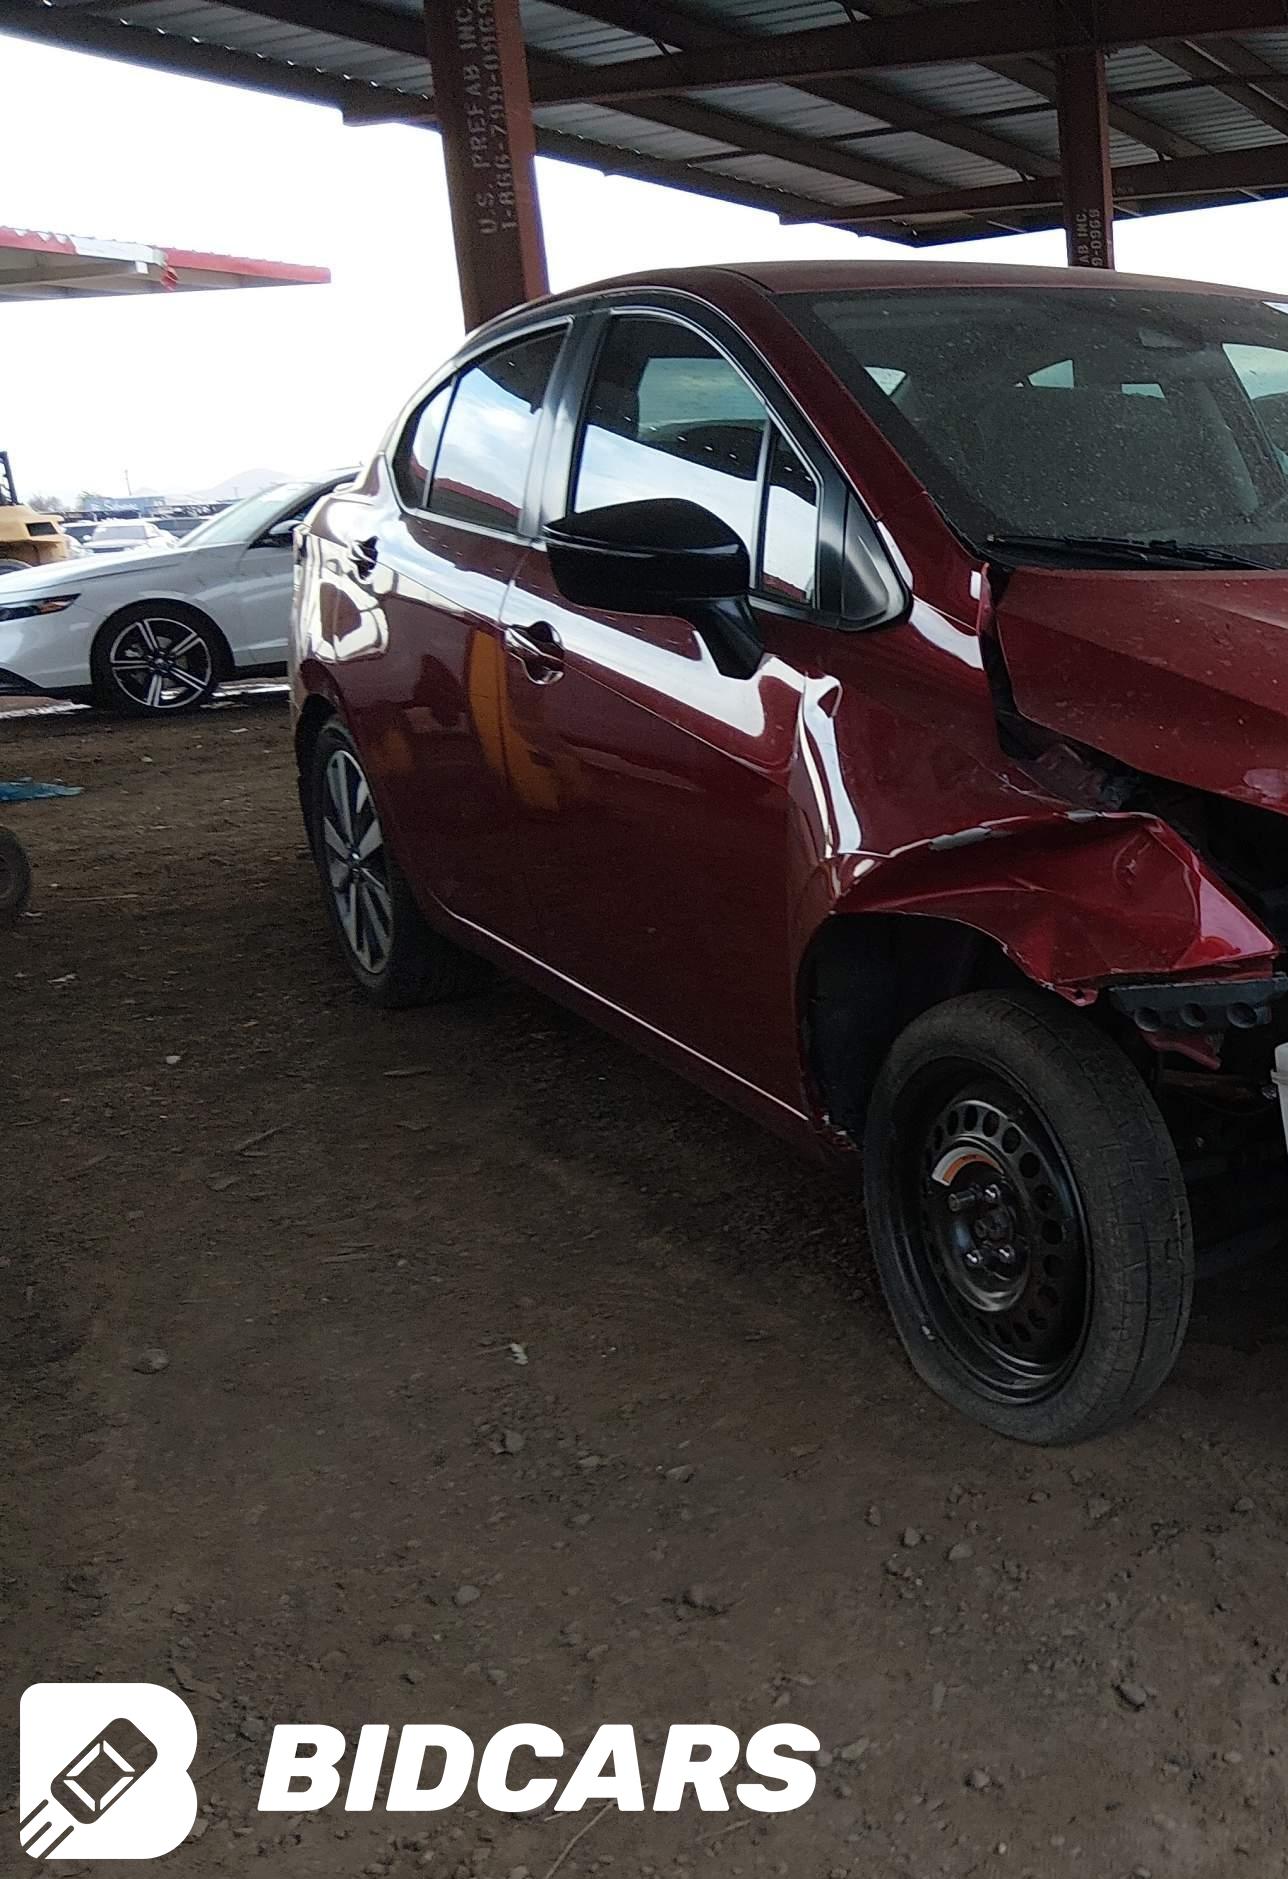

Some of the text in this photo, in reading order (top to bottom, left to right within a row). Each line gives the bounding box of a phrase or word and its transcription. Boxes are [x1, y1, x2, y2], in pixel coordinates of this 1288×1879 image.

[464, 65, 491, 168] PREFAB
[475, 184, 498, 233] U.S.
[1076, 209, 1088, 237] INC.
